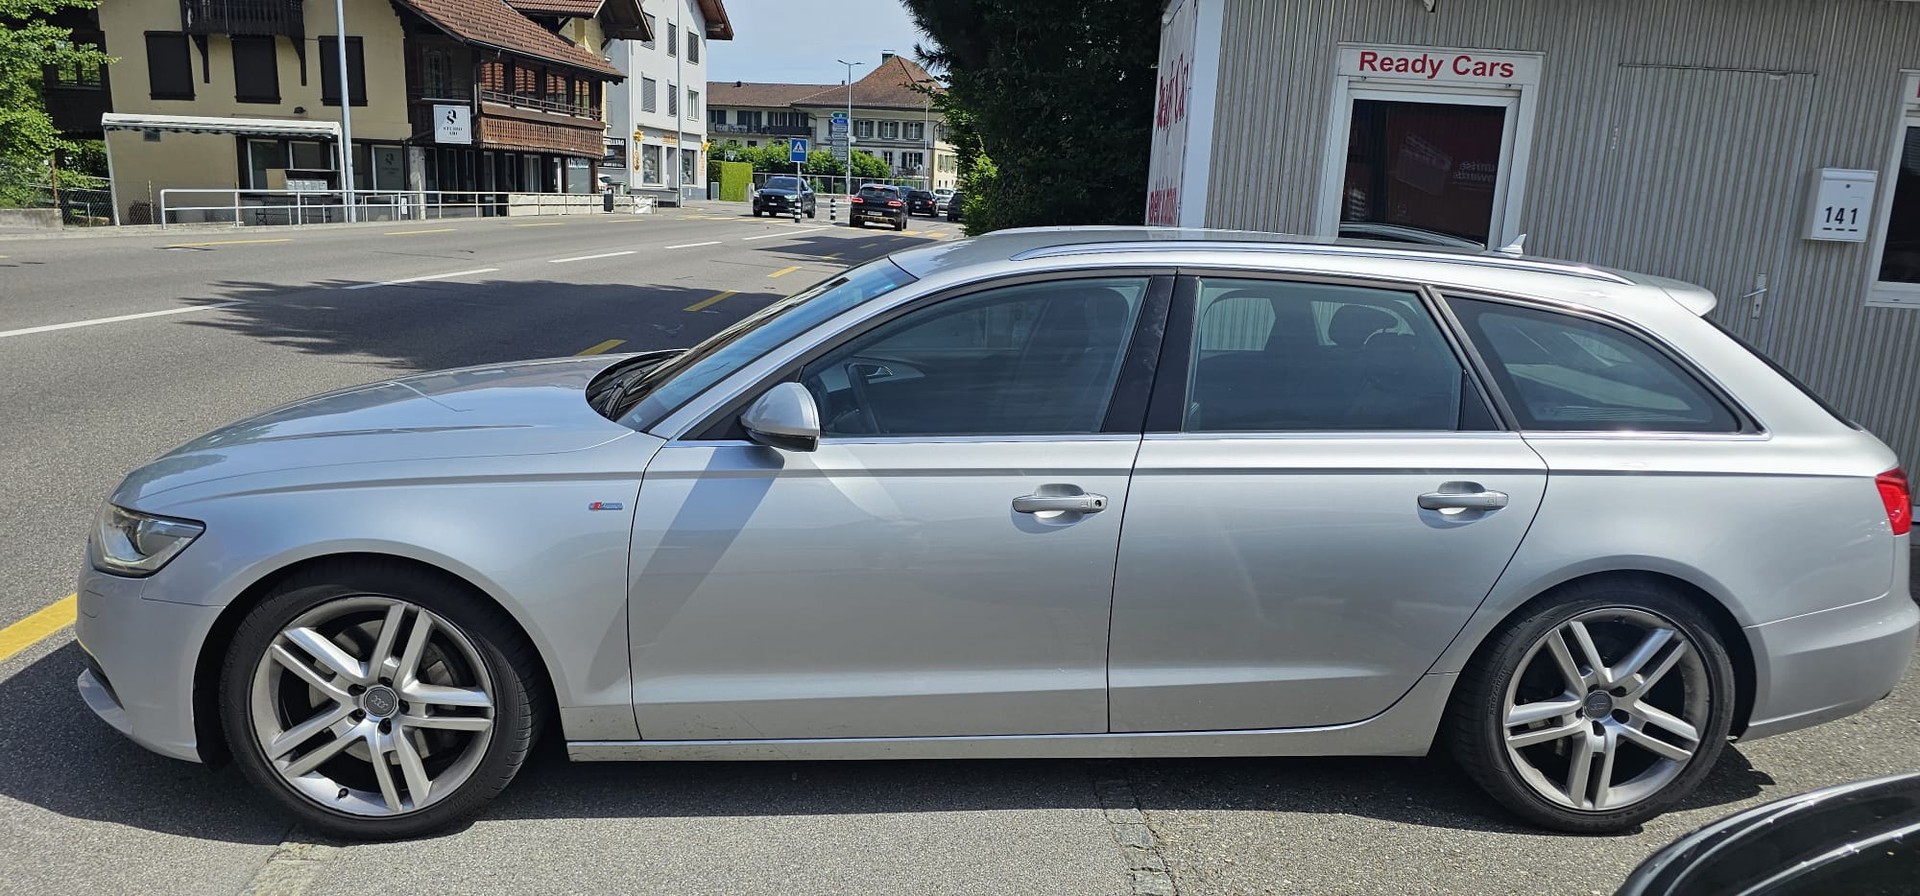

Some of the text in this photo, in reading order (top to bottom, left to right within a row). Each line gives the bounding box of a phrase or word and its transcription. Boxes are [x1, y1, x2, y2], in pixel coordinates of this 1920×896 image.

[1359, 51, 1514, 79] Ready Cars
[1825, 206, 1858, 225] 141
